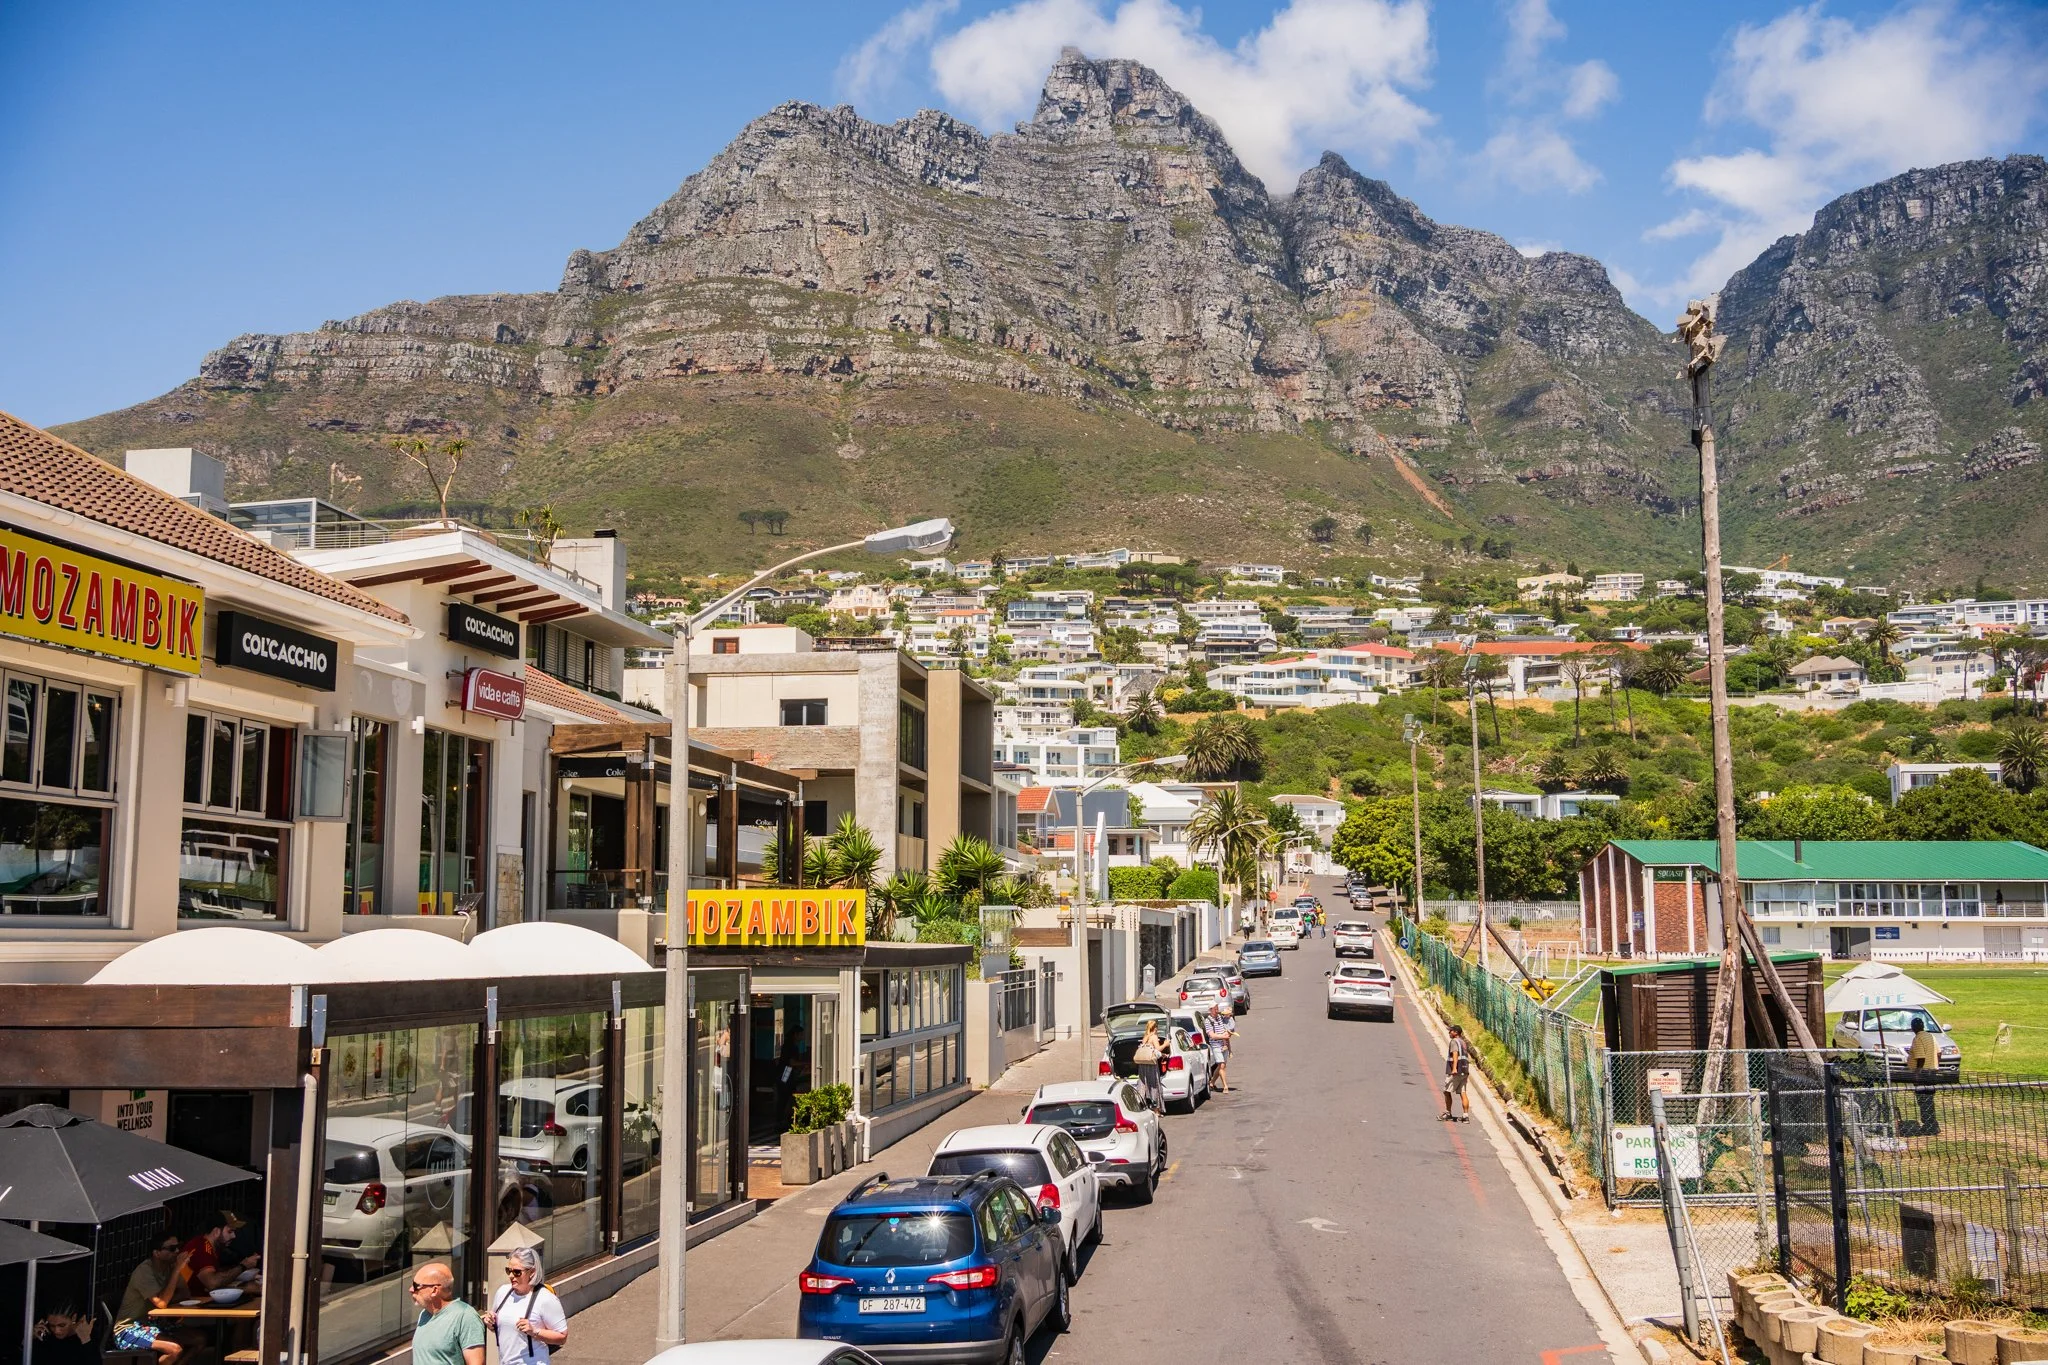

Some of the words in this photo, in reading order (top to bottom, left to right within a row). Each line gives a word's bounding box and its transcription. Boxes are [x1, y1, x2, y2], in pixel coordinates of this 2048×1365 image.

[0, 544, 197, 659] MOZAMBIK
[479, 682, 494, 701] vida
[495, 690, 501, 703] e
[1864, 993, 1905, 1005] LITE
[117, 1103, 134, 1118] INTO
[136, 1100, 153, 1115] YOUR
[117, 1115, 152, 1131] WELLNESS
[862, 1301, 873, 1311] CF
[883, 1299, 921, 1311] 287-472
